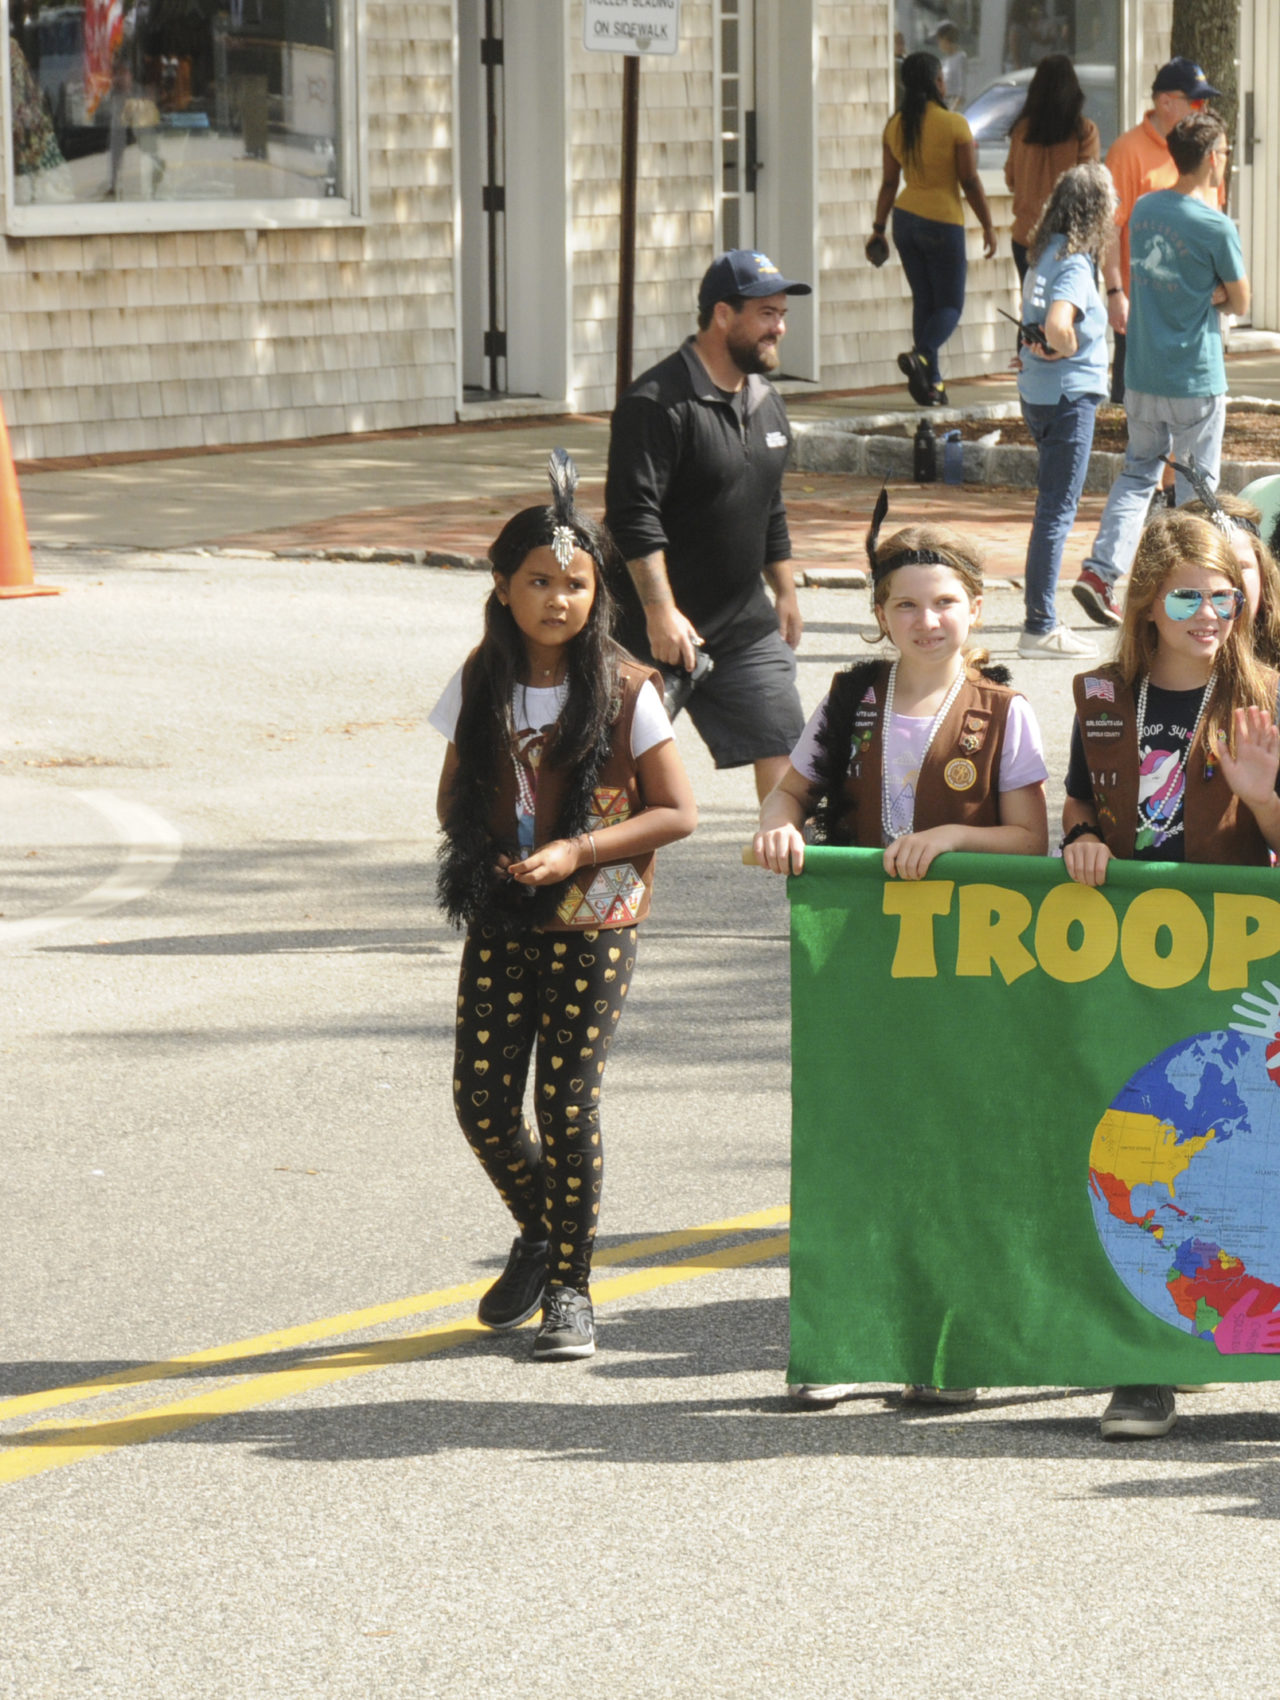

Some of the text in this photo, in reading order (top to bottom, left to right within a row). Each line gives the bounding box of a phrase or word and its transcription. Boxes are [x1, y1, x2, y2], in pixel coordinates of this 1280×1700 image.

[594, 20, 669, 39] ON SIDEWALK
[1143, 723, 1187, 739] OOP 341
